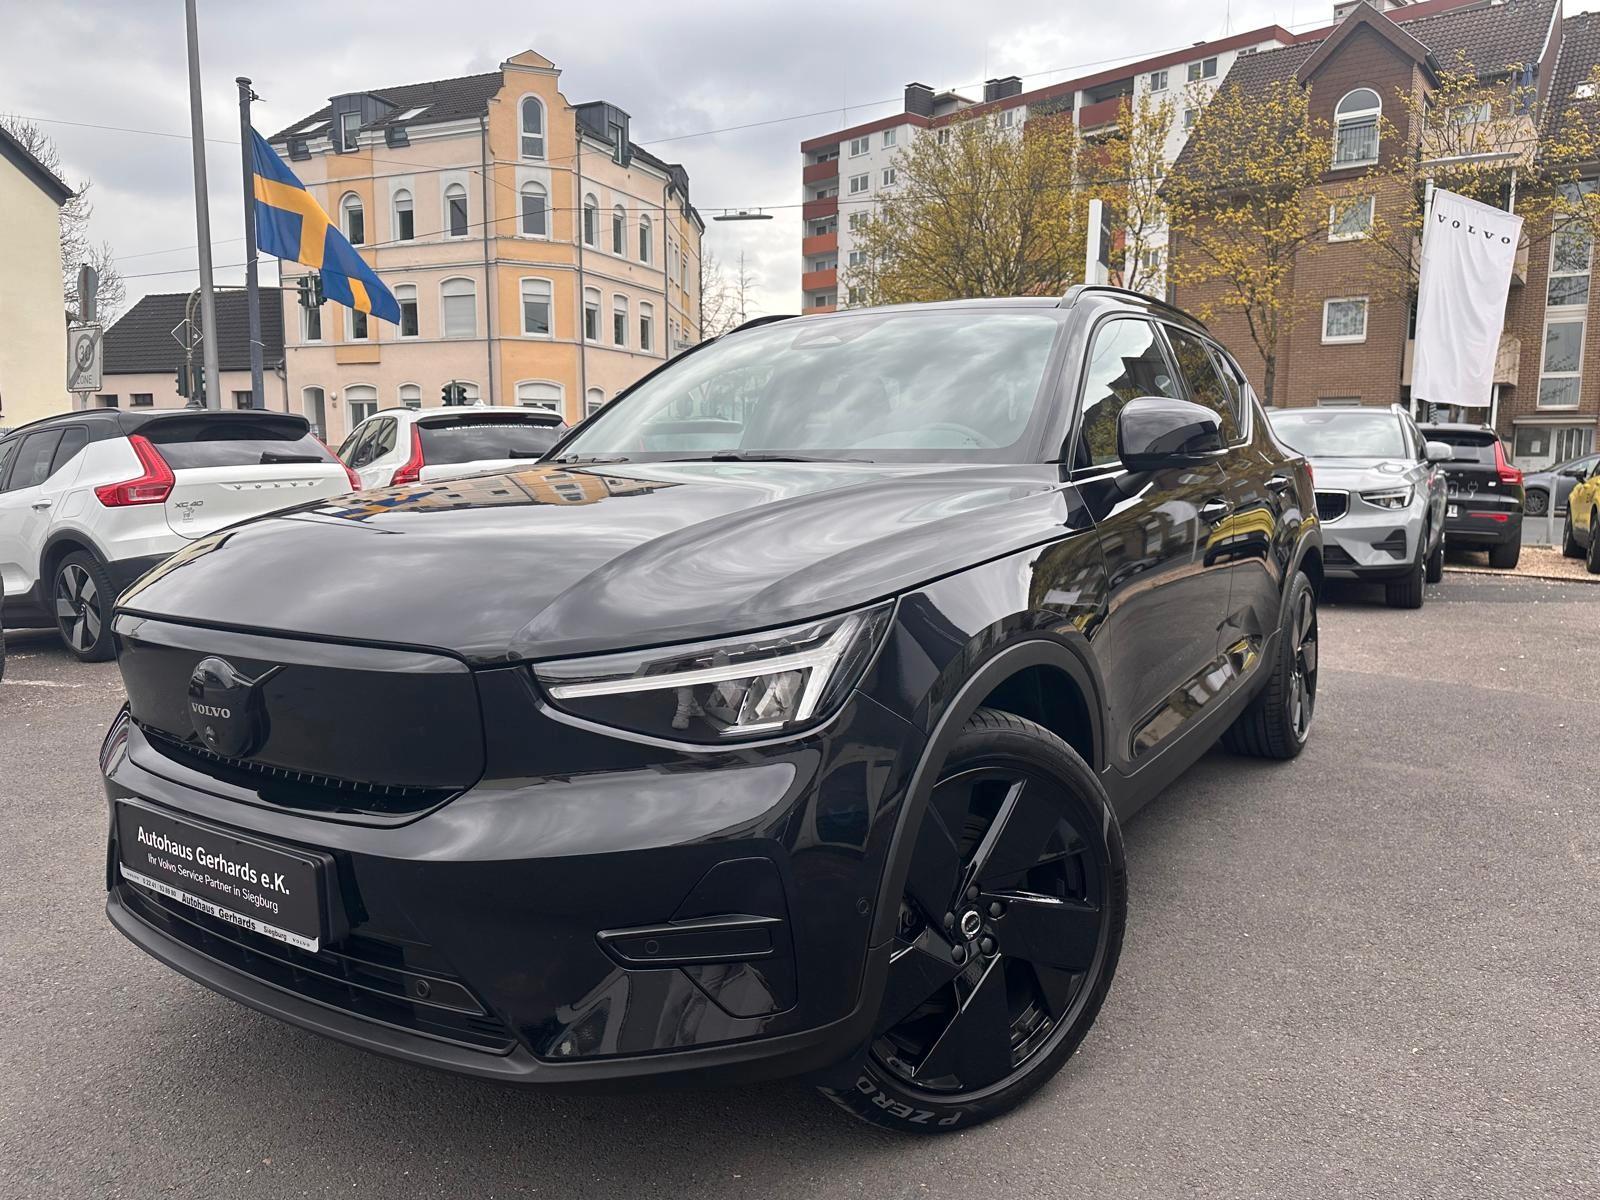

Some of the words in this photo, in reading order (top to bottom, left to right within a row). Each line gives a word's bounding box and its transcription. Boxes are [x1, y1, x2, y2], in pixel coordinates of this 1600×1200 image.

[1437, 214, 1511, 245] VOLVO
[79, 344, 91, 362] 30
[233, 481, 315, 490] VOLVO
[191, 702, 231, 719] VOLVO
[137, 826, 193, 861] Autohaus
[196, 846, 257, 884] Gerhards
[261, 872, 290, 895] e.K.
[147, 852, 158, 865] Ihr
[157, 856, 177, 873] Volvo
[177, 865, 204, 884] Service
[205, 874, 232, 894] Partner
[233, 885, 241, 896] in
[242, 888, 279, 914] Siegburg
[181, 893, 215, 915] Autohaus
[218, 909, 256, 931] Gerhards
[263, 925, 288, 942] Siegburg
[855, 1076, 936, 1125] ZERO
[938, 1111, 962, 1126] P
